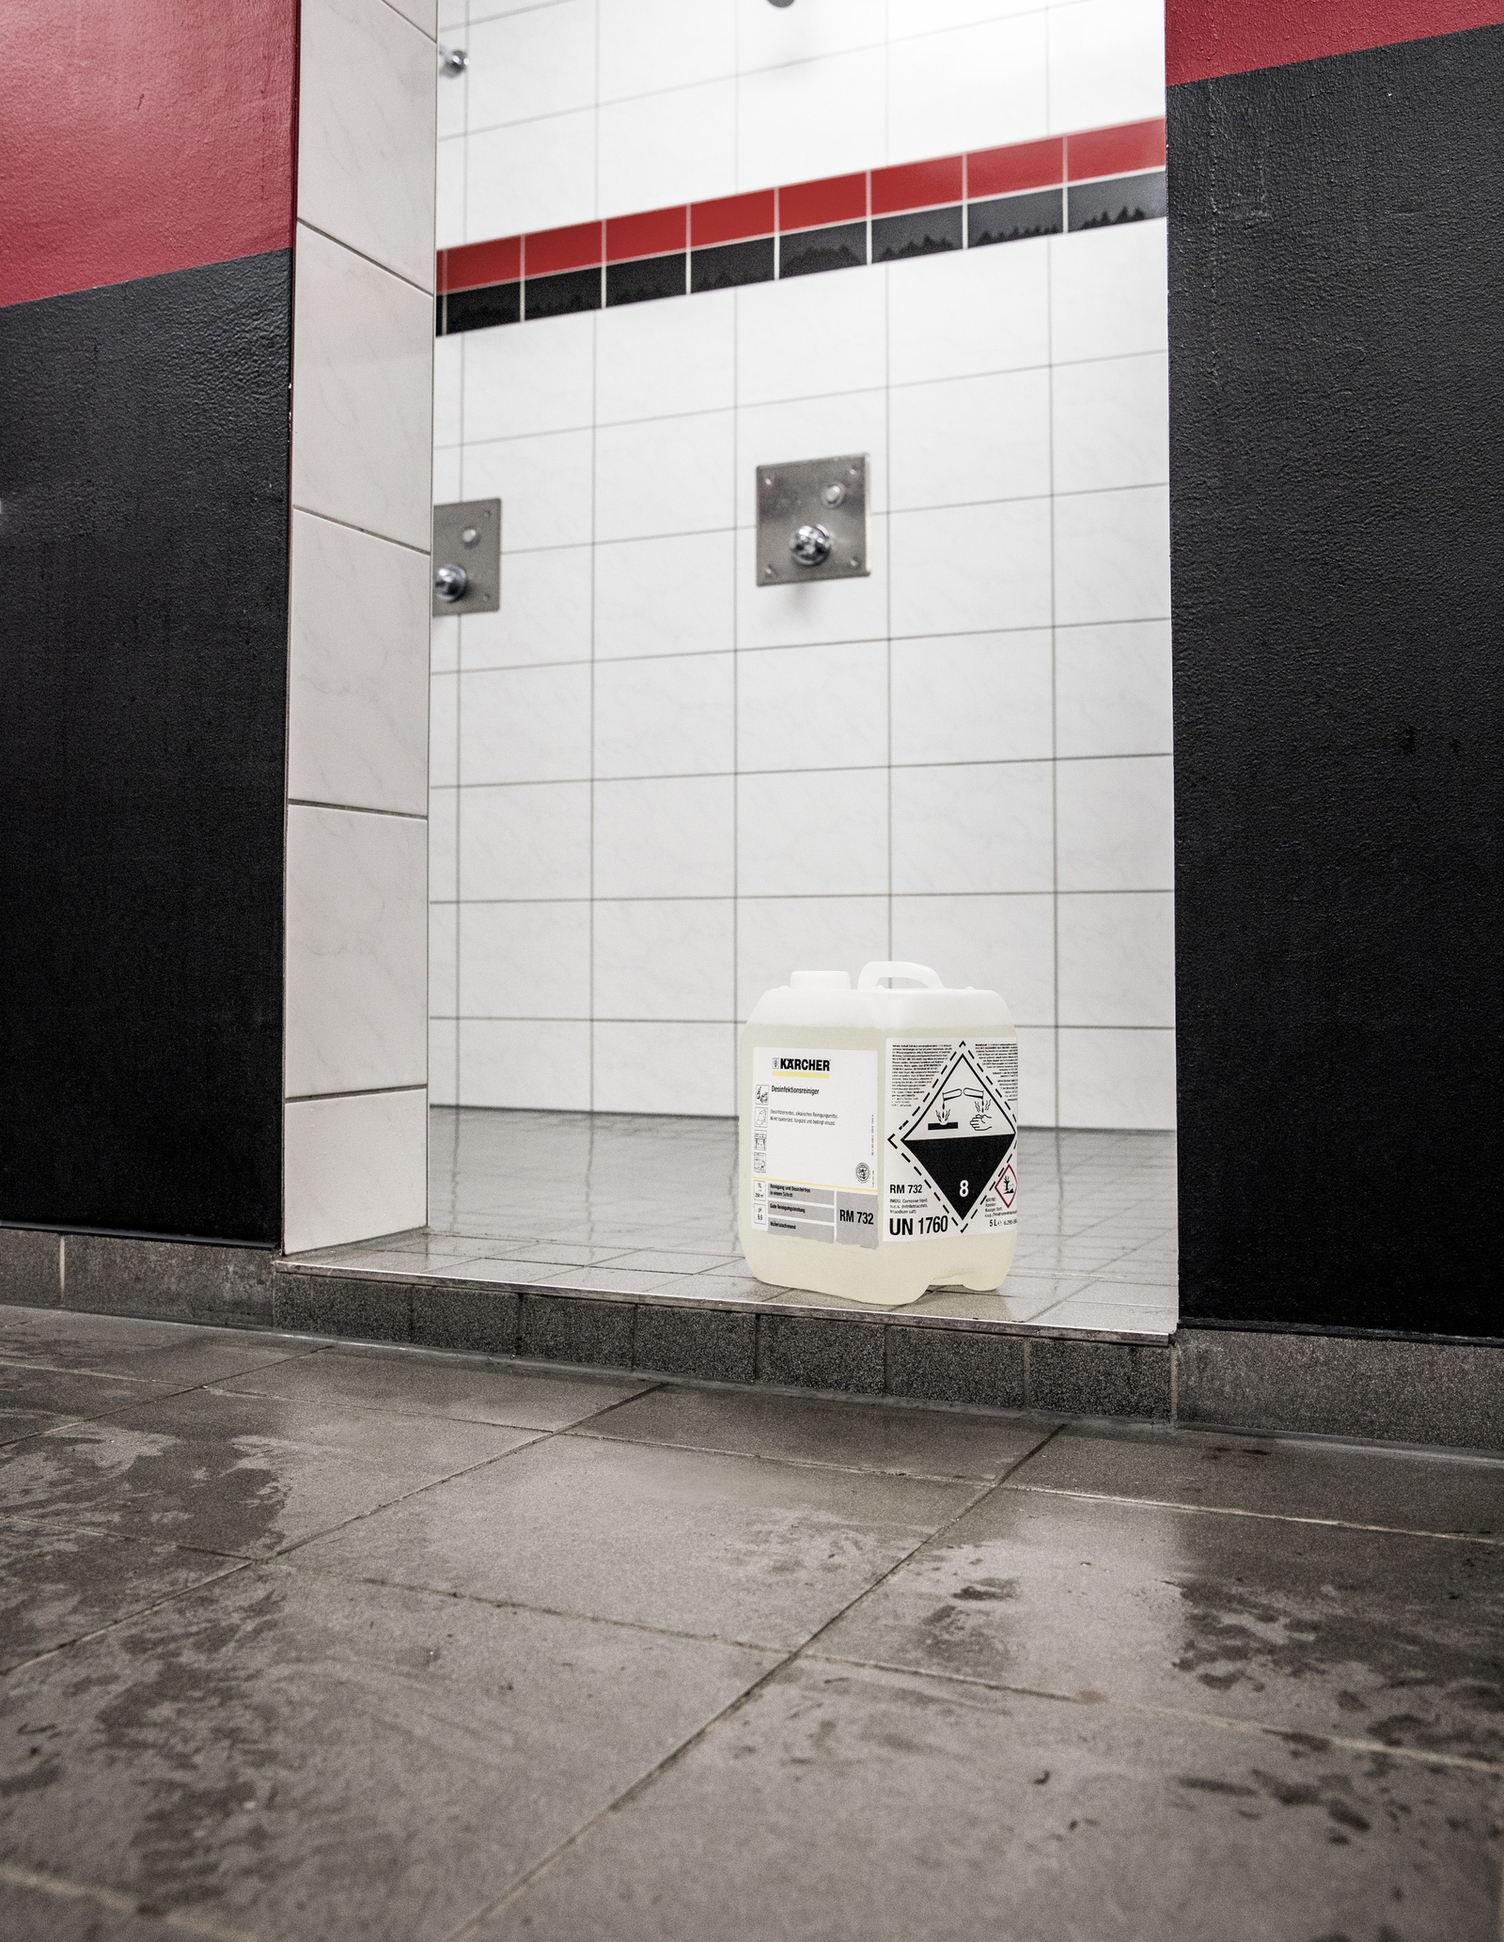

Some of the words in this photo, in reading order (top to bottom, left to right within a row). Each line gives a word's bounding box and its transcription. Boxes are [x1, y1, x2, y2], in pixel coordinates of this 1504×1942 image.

[780, 1058, 830, 1071] KÄRCHER
[771, 1085, 820, 1096] Desinfektionsreiniger
[889, 1184, 905, 1194] RM
[908, 1184, 923, 1194] 732
[959, 1180, 969, 1198] 8
[840, 1209, 854, 1223] RM
[857, 1211, 874, 1225] 732
[889, 1218, 914, 1236] UN
[918, 1215, 949, 1235] 1760
